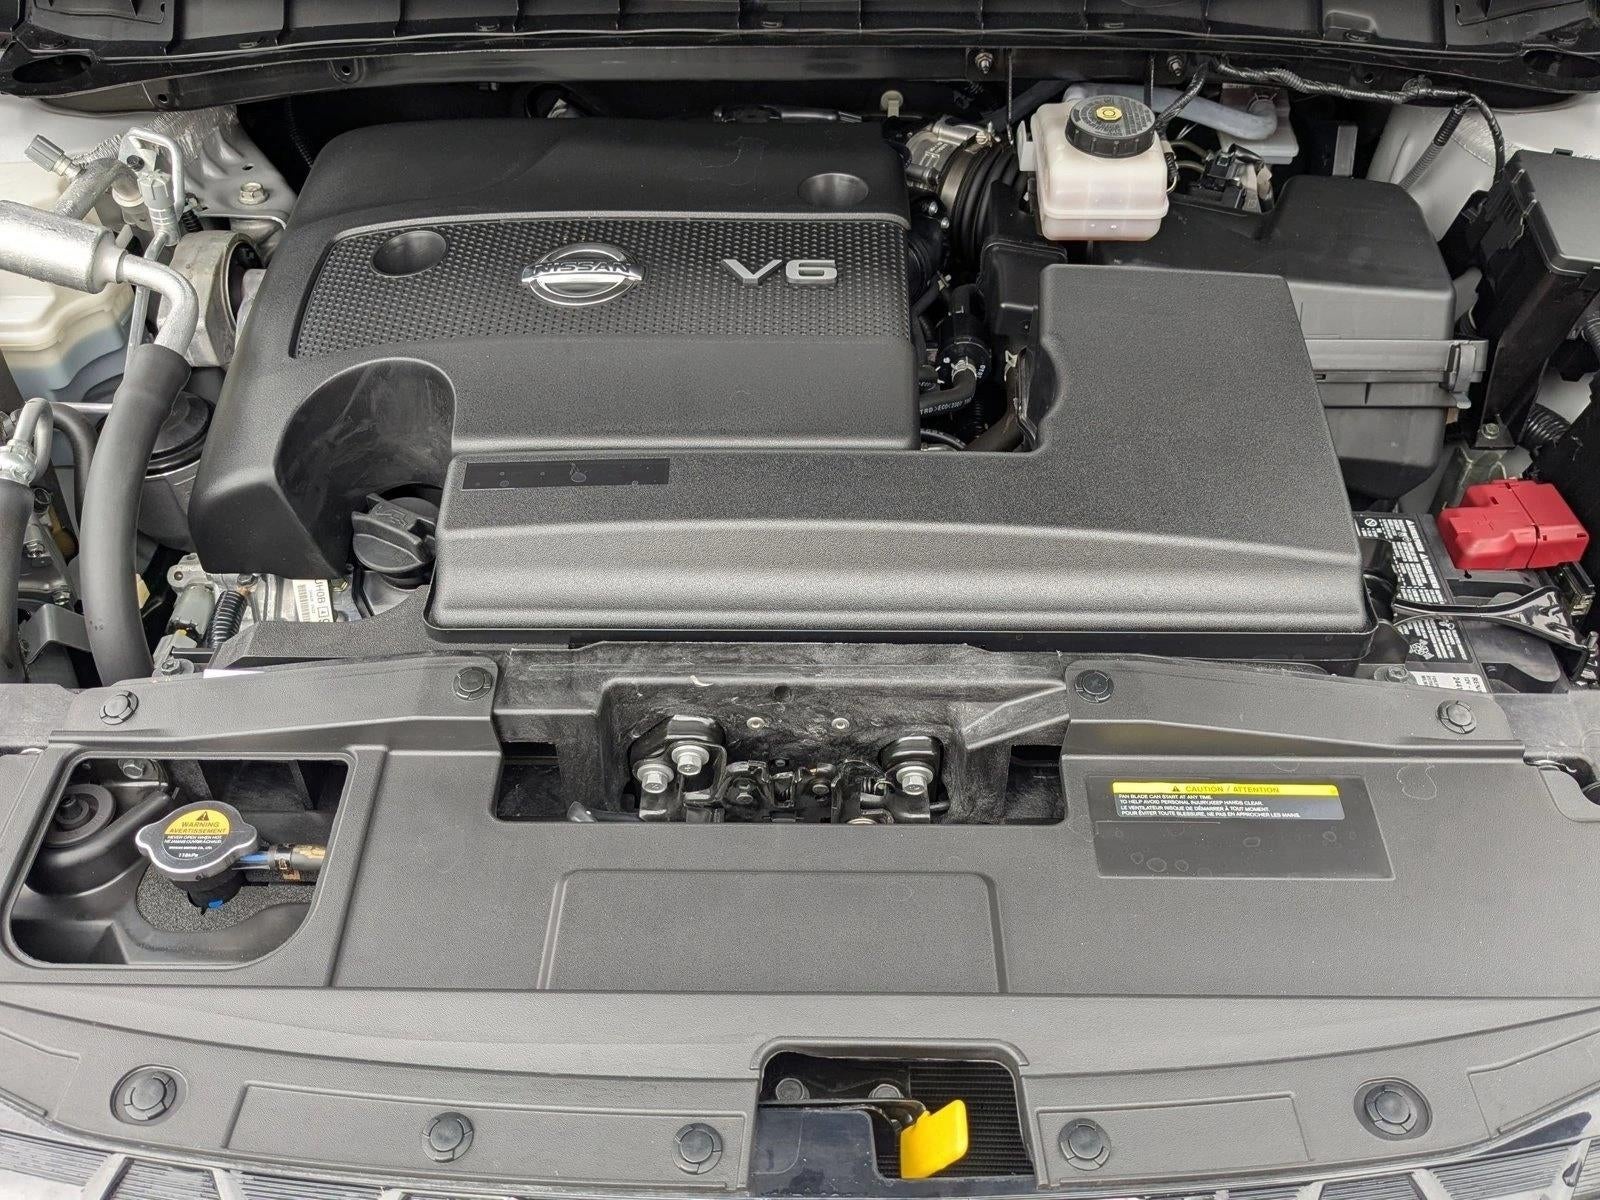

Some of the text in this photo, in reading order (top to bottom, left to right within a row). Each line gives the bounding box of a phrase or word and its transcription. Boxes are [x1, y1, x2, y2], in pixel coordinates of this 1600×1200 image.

[532, 260, 631, 274] NISSAN
[721, 259, 838, 286] V6
[1185, 785, 1224, 793] CAUTION
